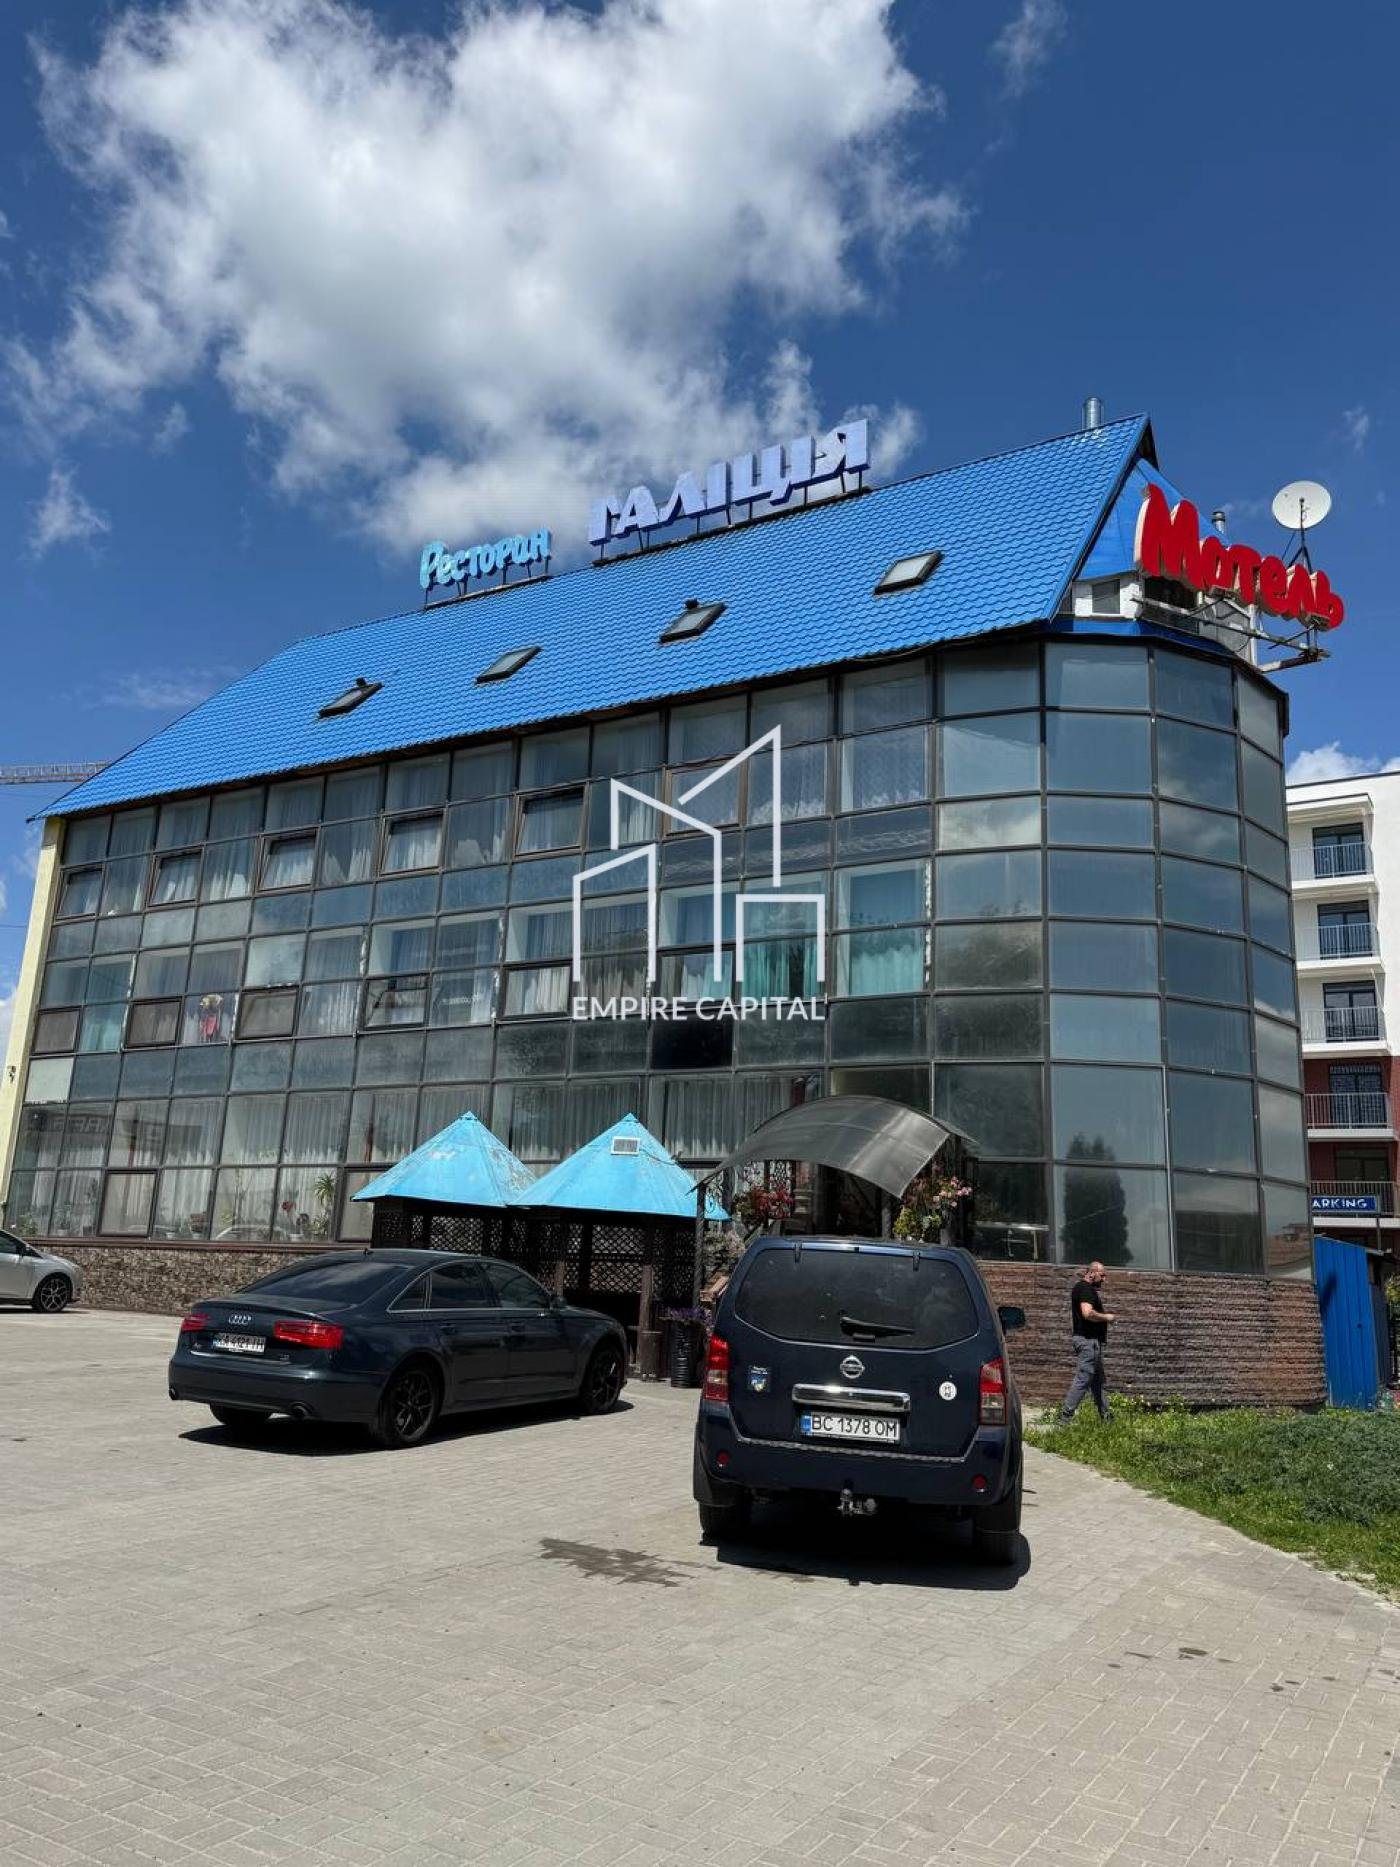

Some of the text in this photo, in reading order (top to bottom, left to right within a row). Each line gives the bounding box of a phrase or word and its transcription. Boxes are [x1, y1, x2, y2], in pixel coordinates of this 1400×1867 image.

[420, 528, 551, 589] Ресторан
[1135, 483, 1345, 631] Мотель
[1312, 1198, 1367, 1209] ARKING
[812, 1415, 896, 1437] BC 1378 OM
